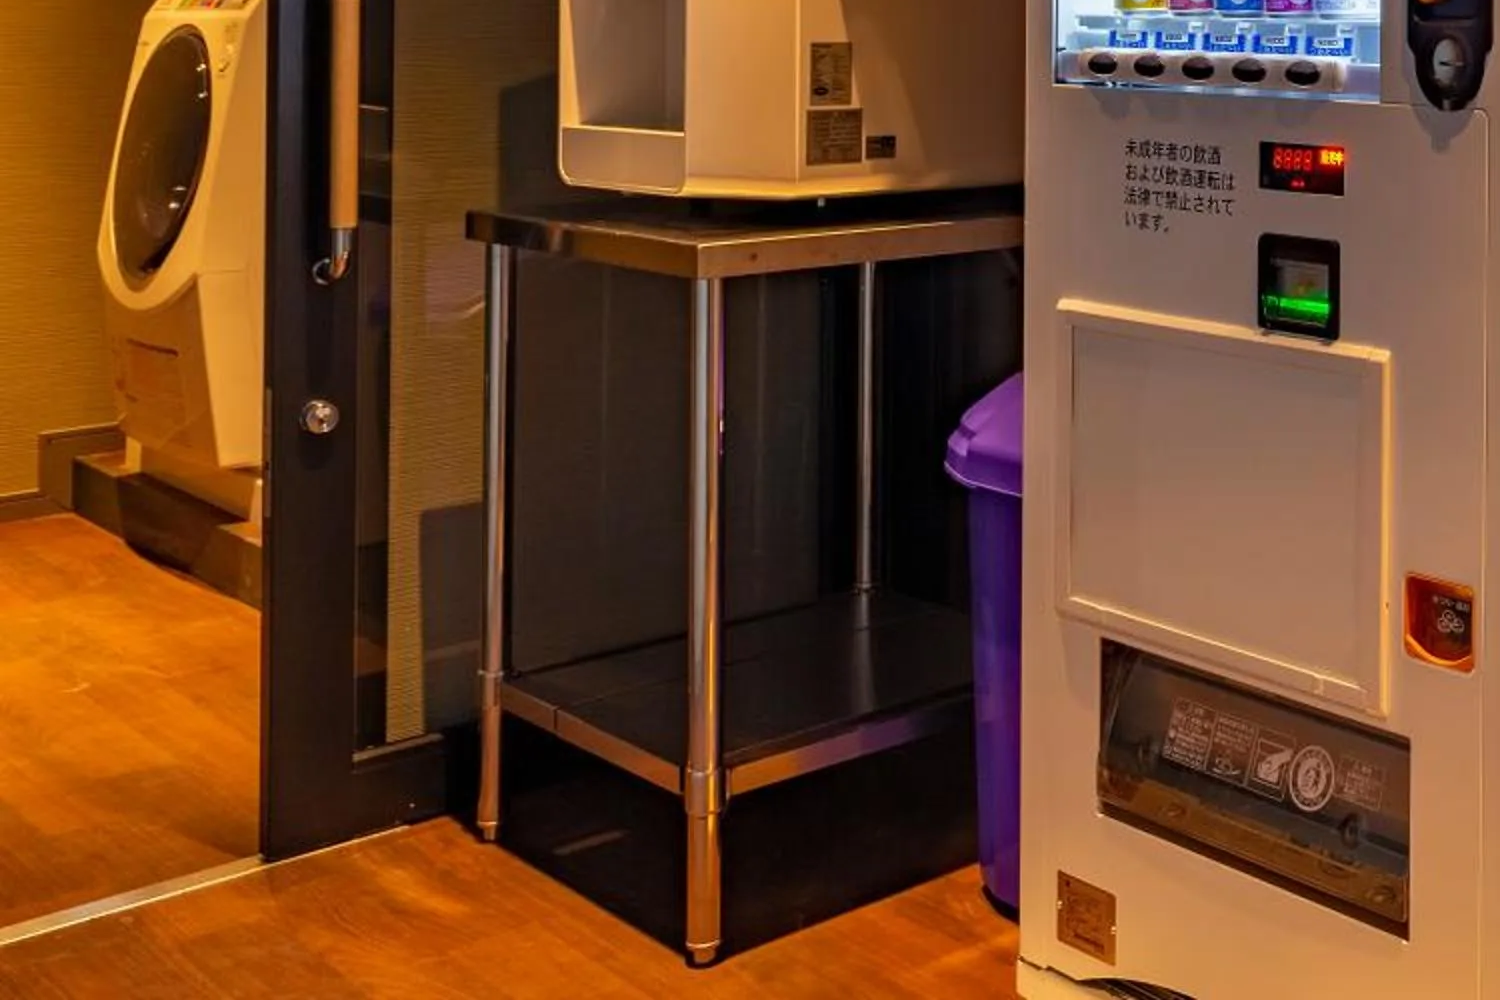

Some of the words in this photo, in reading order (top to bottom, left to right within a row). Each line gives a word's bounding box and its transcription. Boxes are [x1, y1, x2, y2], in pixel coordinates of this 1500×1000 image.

[1125, 140, 1221, 166] 未成年者の飲酒
[1125, 164, 1236, 190] および飲酒運転は
[1124, 188, 1235, 217] 法律で禁止されて
[1125, 214, 1170, 233] います。
